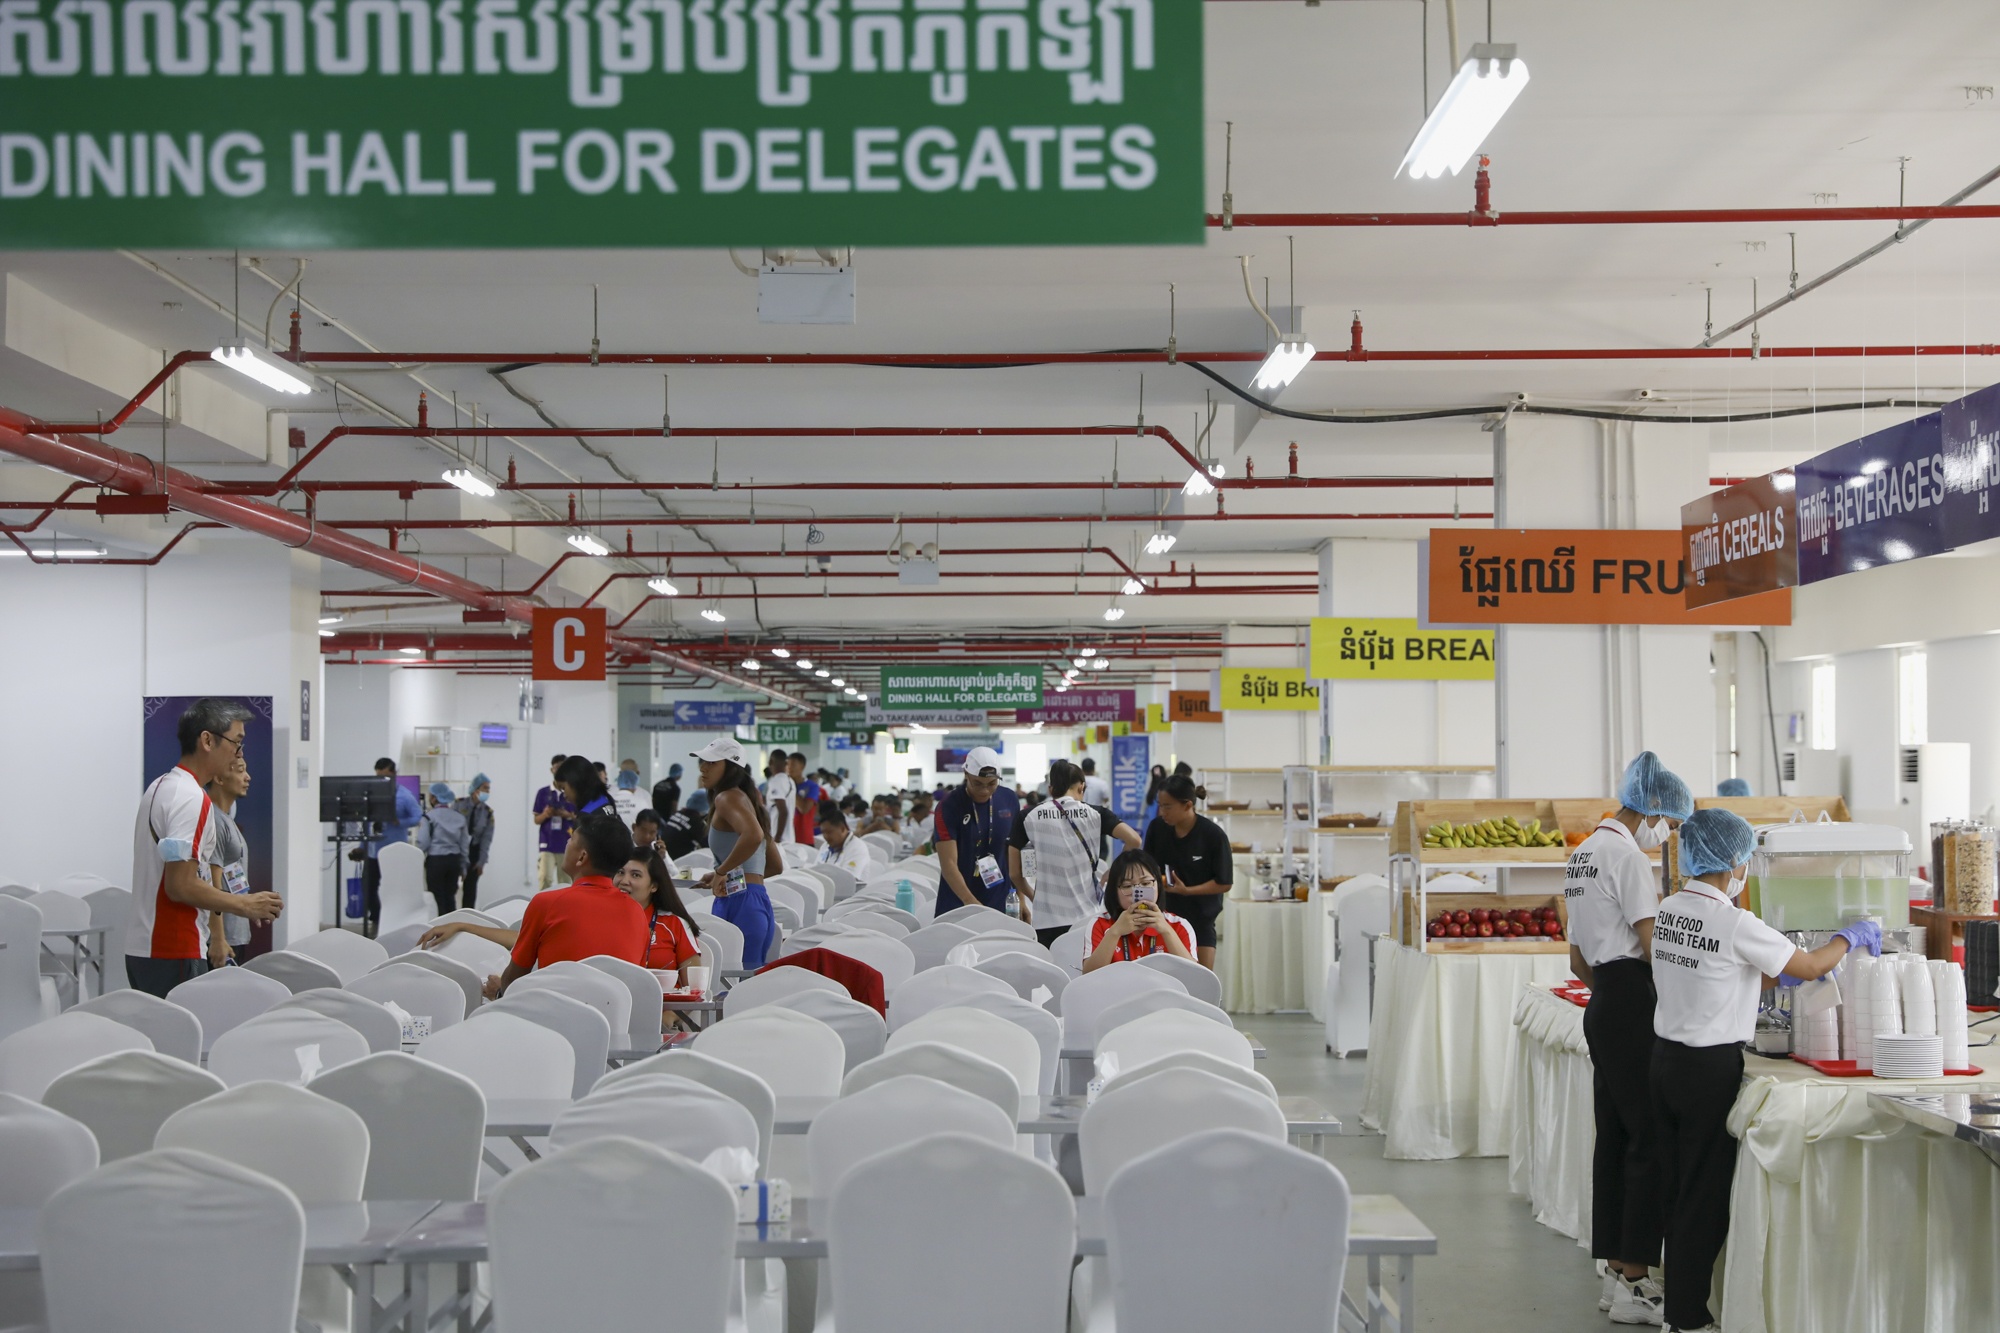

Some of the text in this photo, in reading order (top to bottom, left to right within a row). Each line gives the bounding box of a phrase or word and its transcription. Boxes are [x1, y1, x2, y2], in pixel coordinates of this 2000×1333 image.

[0, 125, 1158, 199] DINING HALL FOR DELEGATES
[1834, 453, 1945, 531] BEVERAGES
[1722, 505, 1785, 562] CEREALS
[553, 616, 586, 672] C
[1404, 637, 1495, 662] BREA
[887, 693, 923, 704] DINING
[924, 693, 951, 703] HALL
[953, 692, 975, 703] FOR
[977, 691, 1037, 703] DELEGATES
[870, 714, 884, 723] NO
[886, 714, 936, 723] TAKEAWAY
[937, 713, 983, 722] ALLOWED
[1032, 710, 1120, 721] MILK & YOGURT
[774, 726, 800, 741] EXIT
[855, 732, 868, 743] D
[1114, 755, 1137, 812] milk
[1037, 808, 1088, 820] PHILIPPINES
[1658, 910, 1703, 933] FUN FOOD
[1687, 933, 1720, 953] TEAM
[1655, 949, 1699, 969] SERVICE CREW
